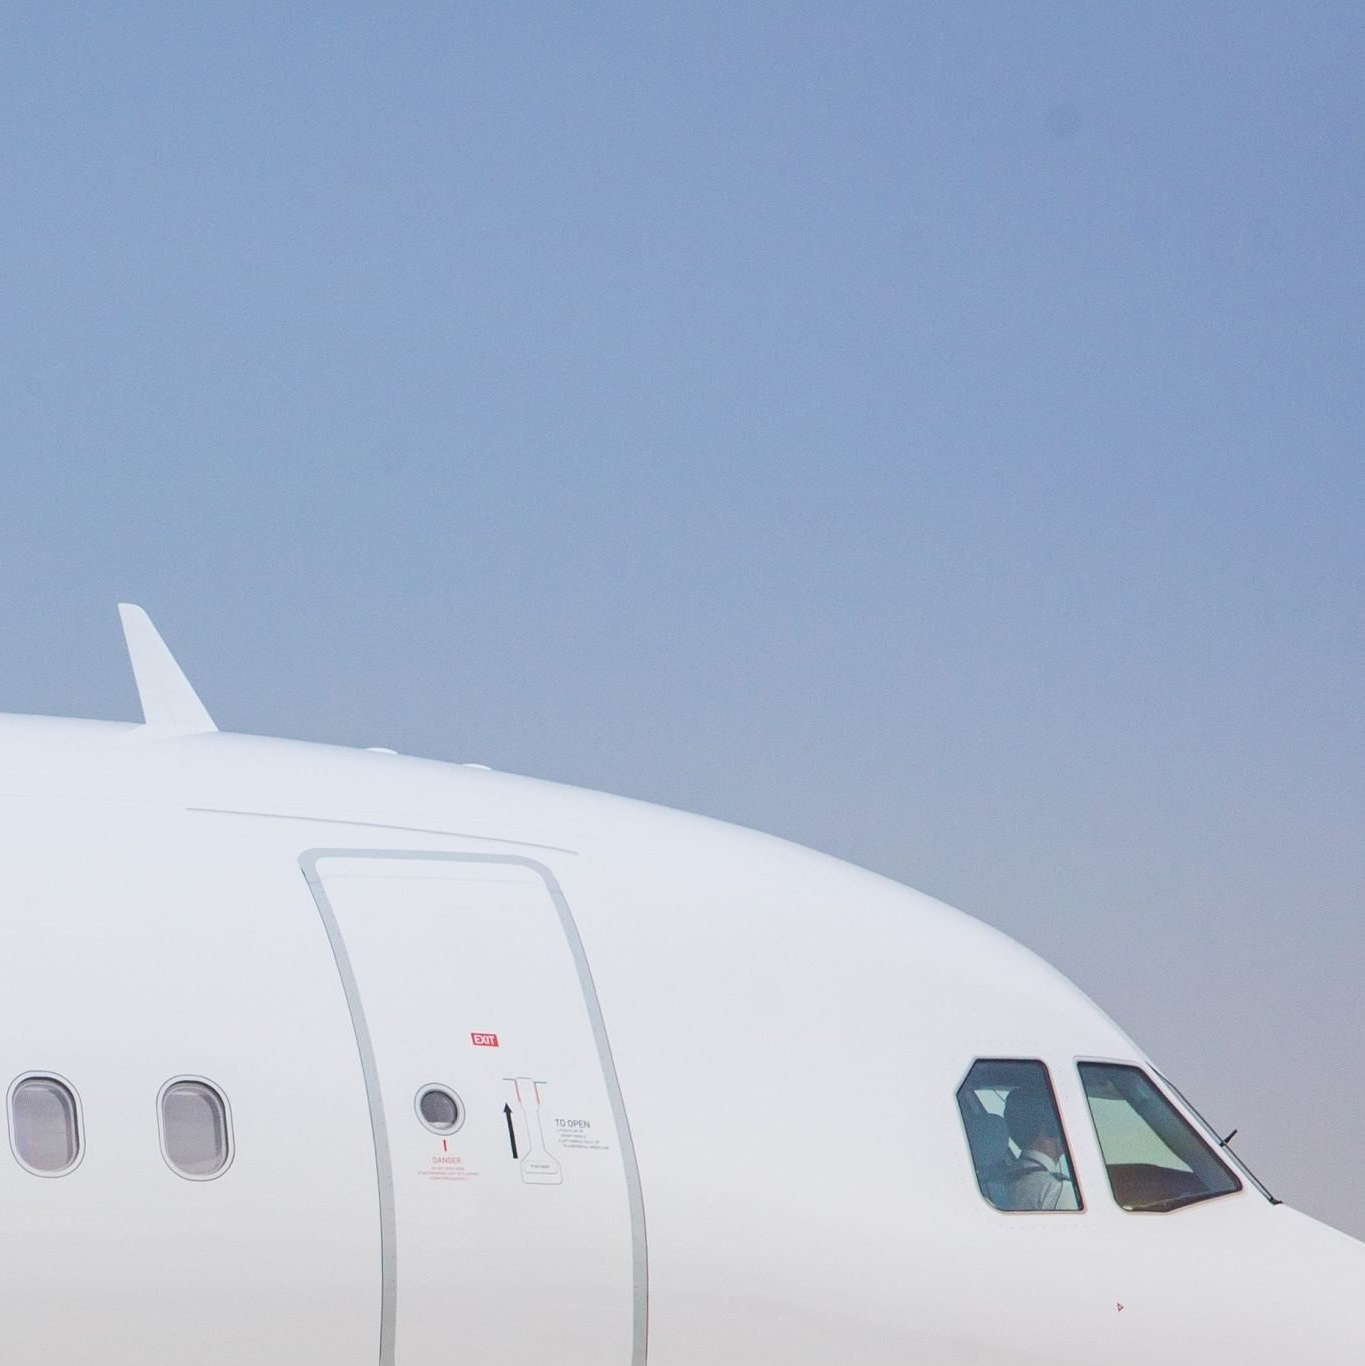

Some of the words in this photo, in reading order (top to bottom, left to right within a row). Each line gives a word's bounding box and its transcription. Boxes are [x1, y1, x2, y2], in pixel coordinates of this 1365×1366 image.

[474, 1034, 496, 1046] EXIT
[554, 1118, 566, 1128] TO
[567, 1119, 591, 1129] OPEN
[432, 1156, 462, 1165] DANGER
